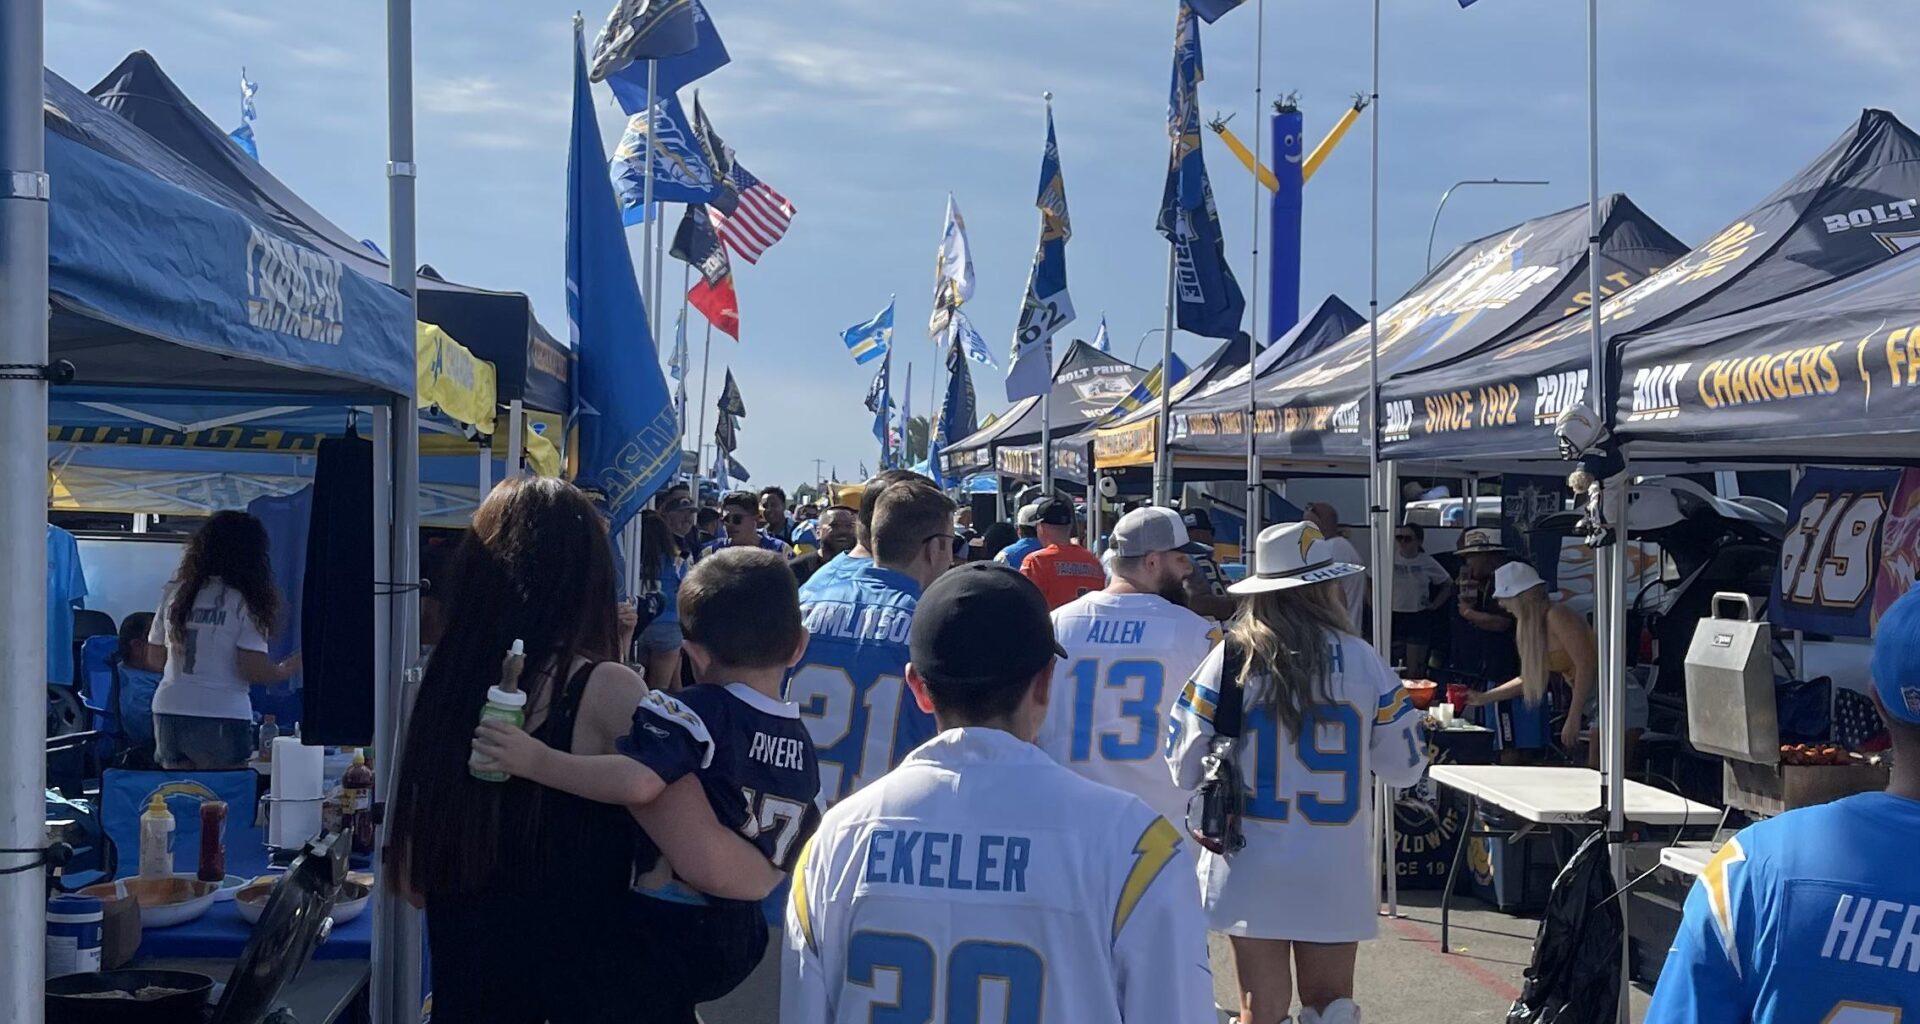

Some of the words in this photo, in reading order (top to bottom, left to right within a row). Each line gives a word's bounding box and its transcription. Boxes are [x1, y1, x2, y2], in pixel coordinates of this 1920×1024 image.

[1822, 198, 1917, 234] BOLT
[1057, 367, 1090, 386] BOLT
[1092, 364, 1132, 376] PRIDE
[1384, 399, 1415, 443] BOLT
[1424, 390, 1474, 435] SINCE
[1479, 382, 1521, 428] 1992
[1533, 368, 1589, 427] PRIDE
[1627, 362, 1693, 422] BOLT
[1697, 340, 1845, 410] CHARGERS
[1779, 491, 1888, 608] 619
[800, 601, 912, 646] OMLINSO
[1086, 619, 1147, 645] ALLEN
[788, 662, 906, 802] 21
[1066, 657, 1166, 764] 13
[1243, 700, 1362, 827] 19
[865, 829, 1032, 893] EKELER
[1820, 893, 1920, 973] HER
